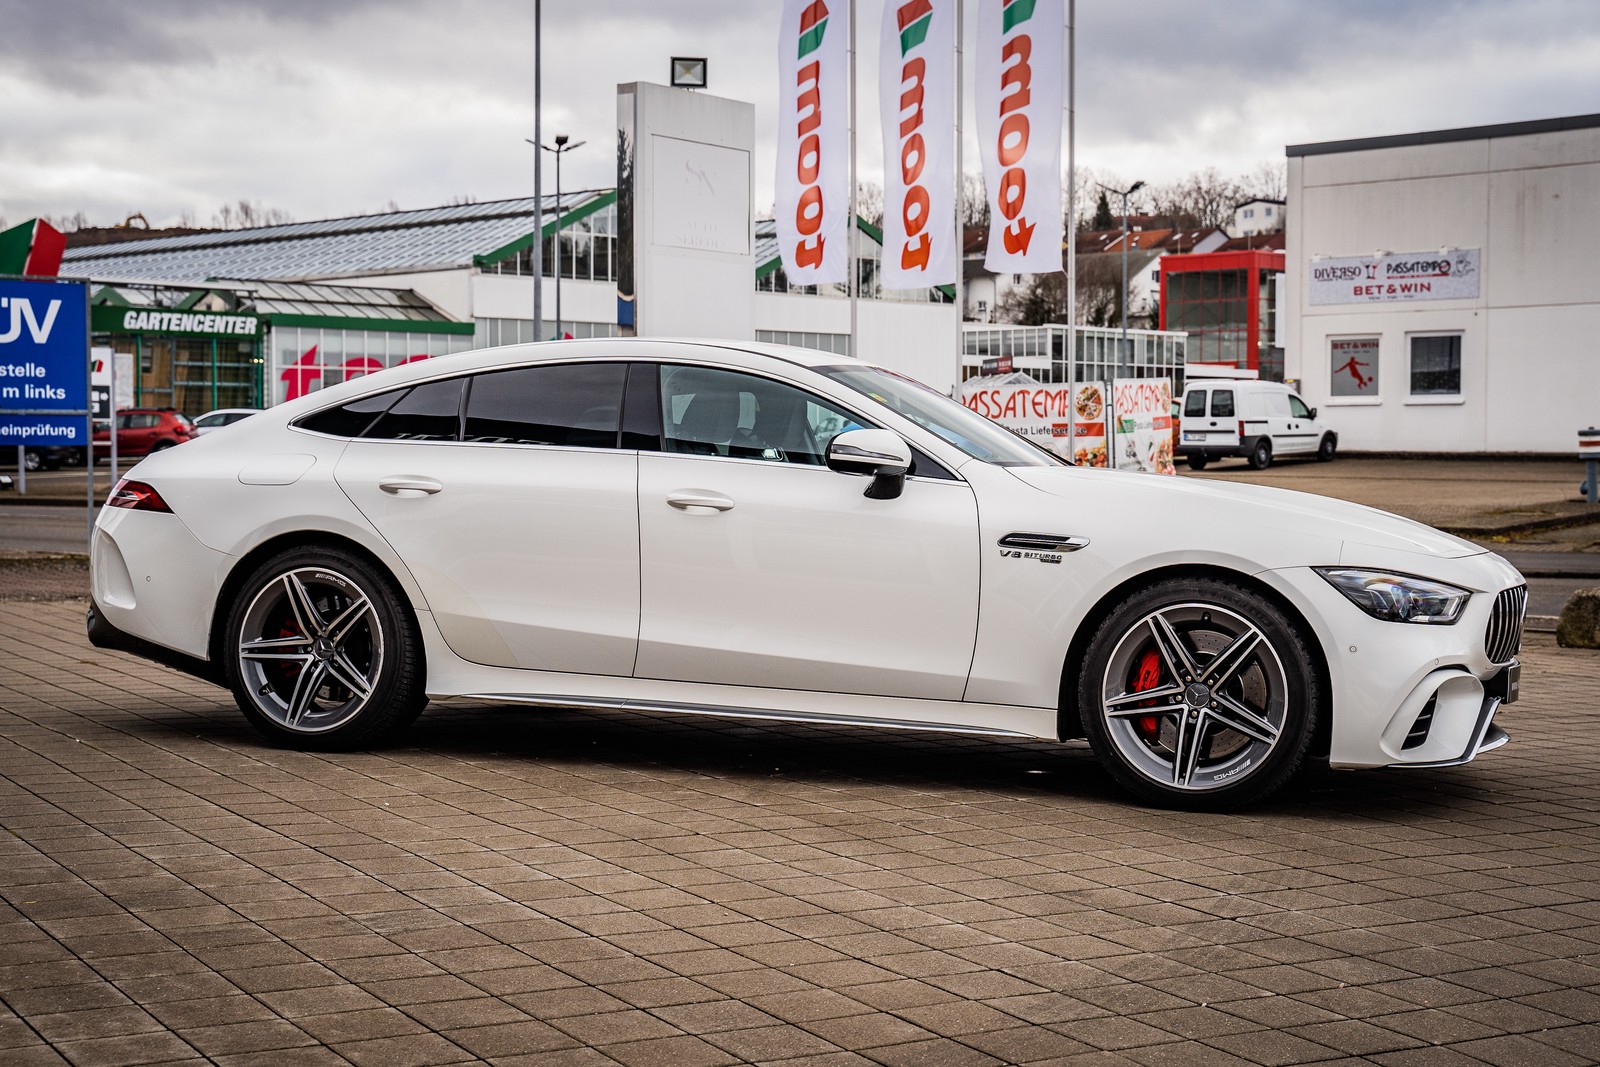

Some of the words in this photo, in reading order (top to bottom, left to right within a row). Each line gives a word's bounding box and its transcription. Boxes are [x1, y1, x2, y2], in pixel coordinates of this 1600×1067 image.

[123, 310, 257, 335] GARTENCENTER
[0, 362, 46, 378] stelle
[3, 387, 20, 398] m
[25, 384, 66, 399] links
[962, 388, 1068, 419] ASSATEMP
[0, 424, 76, 439] einprüfung
[999, 550, 1022, 558] V8
[1023, 552, 1062, 560] BITURBO
